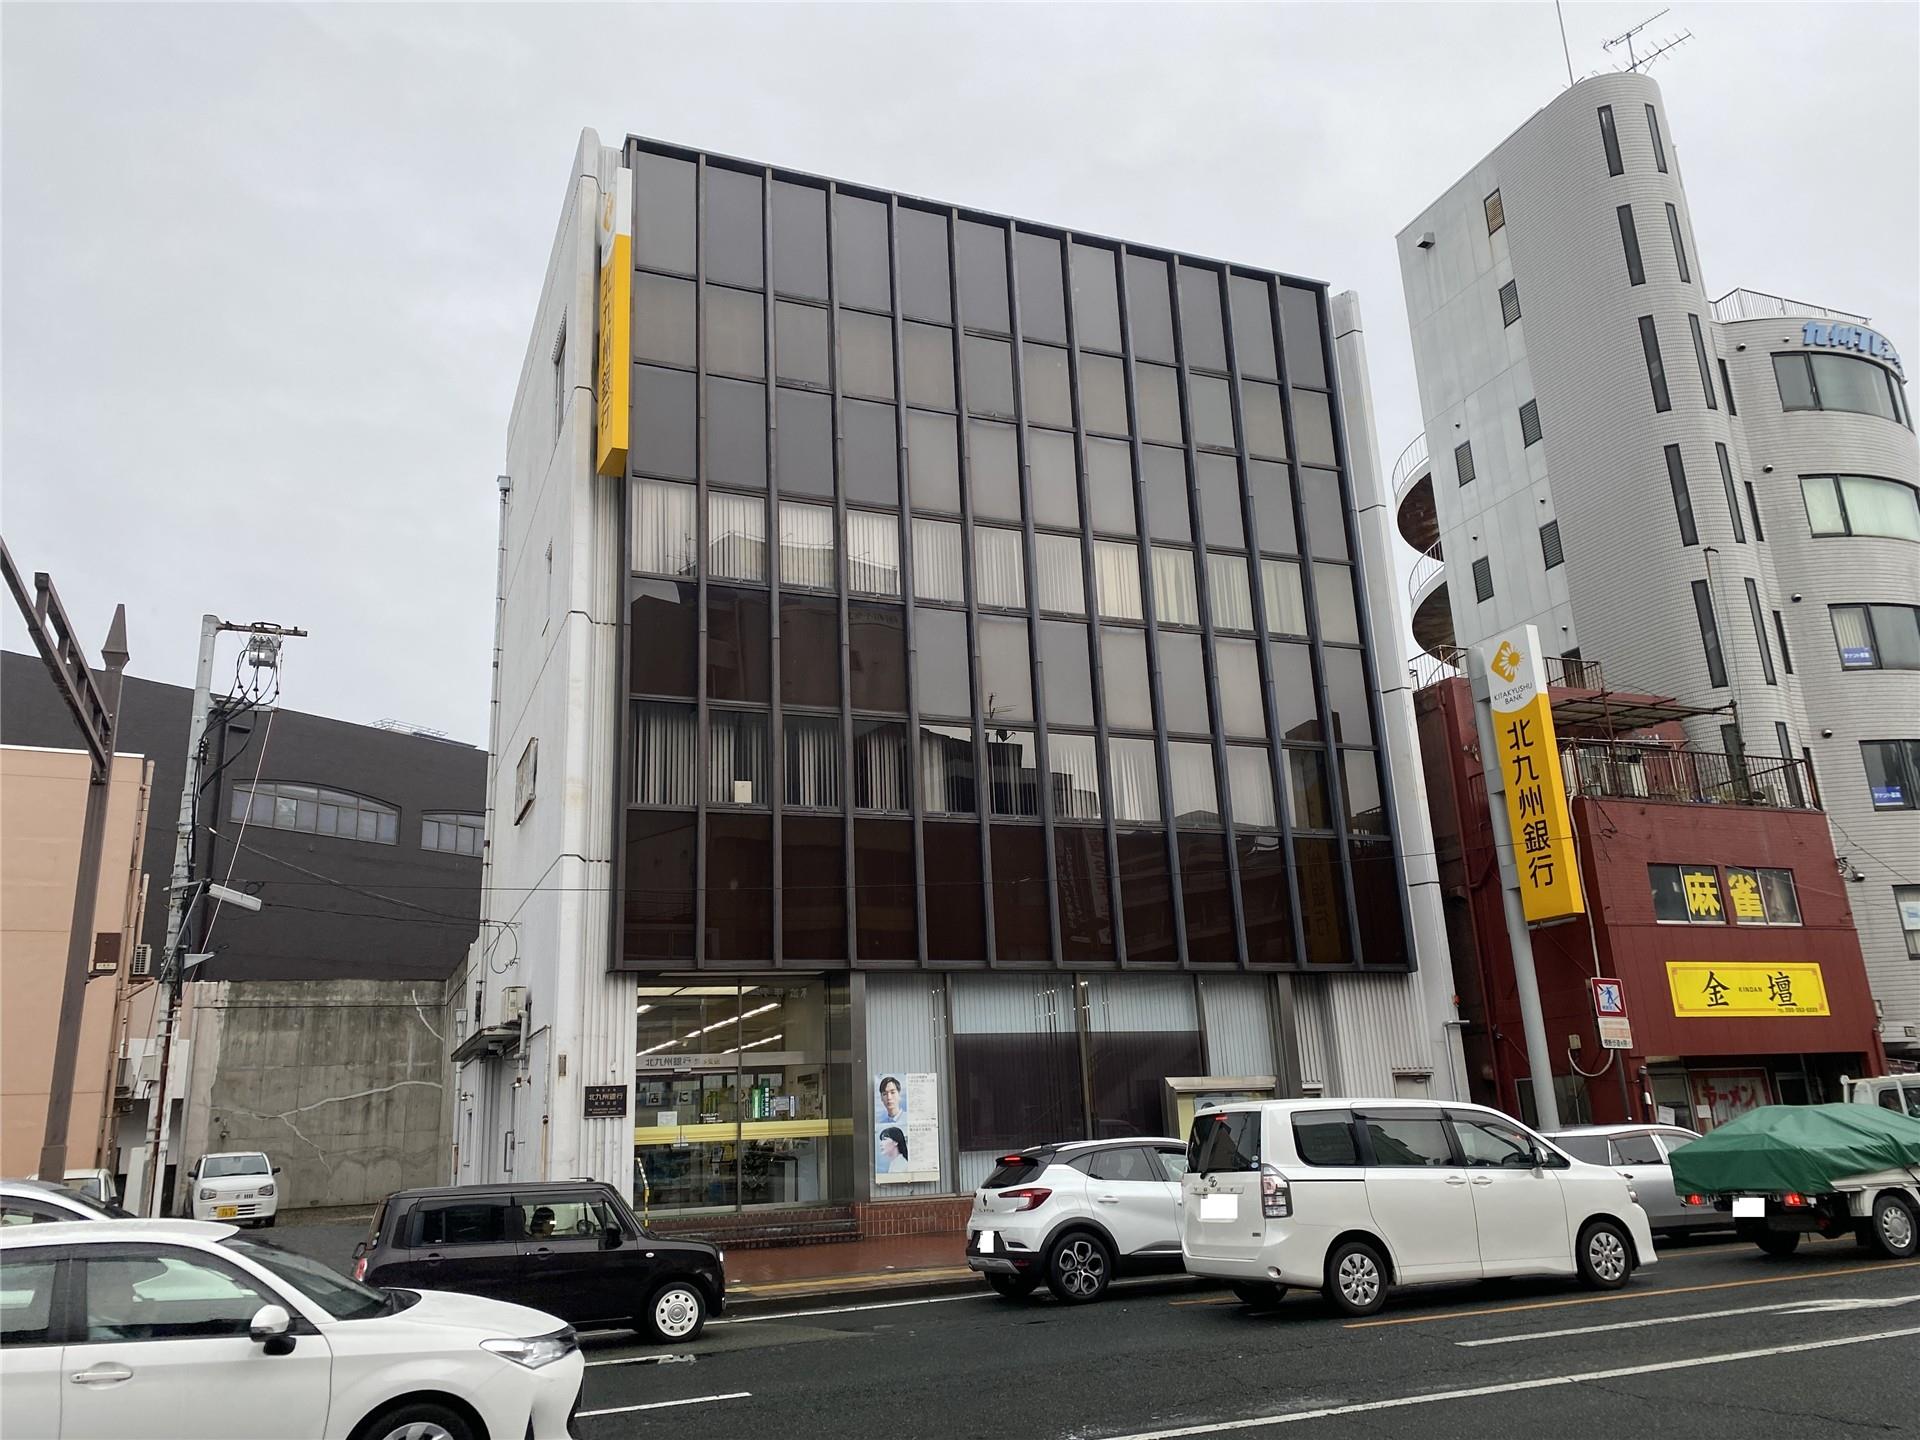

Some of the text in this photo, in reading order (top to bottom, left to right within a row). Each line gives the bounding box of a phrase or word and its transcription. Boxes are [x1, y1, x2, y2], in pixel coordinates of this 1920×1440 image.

[1493, 682, 1533, 701] KITAKYUSHU
[1504, 694, 1523, 705] BANK
[1507, 719, 1555, 888] 北九州銀行
[1684, 872, 1764, 917] 麻雀
[1702, 971, 1730, 1007] 金
[646, 1056, 691, 1067] 北九州銀行
